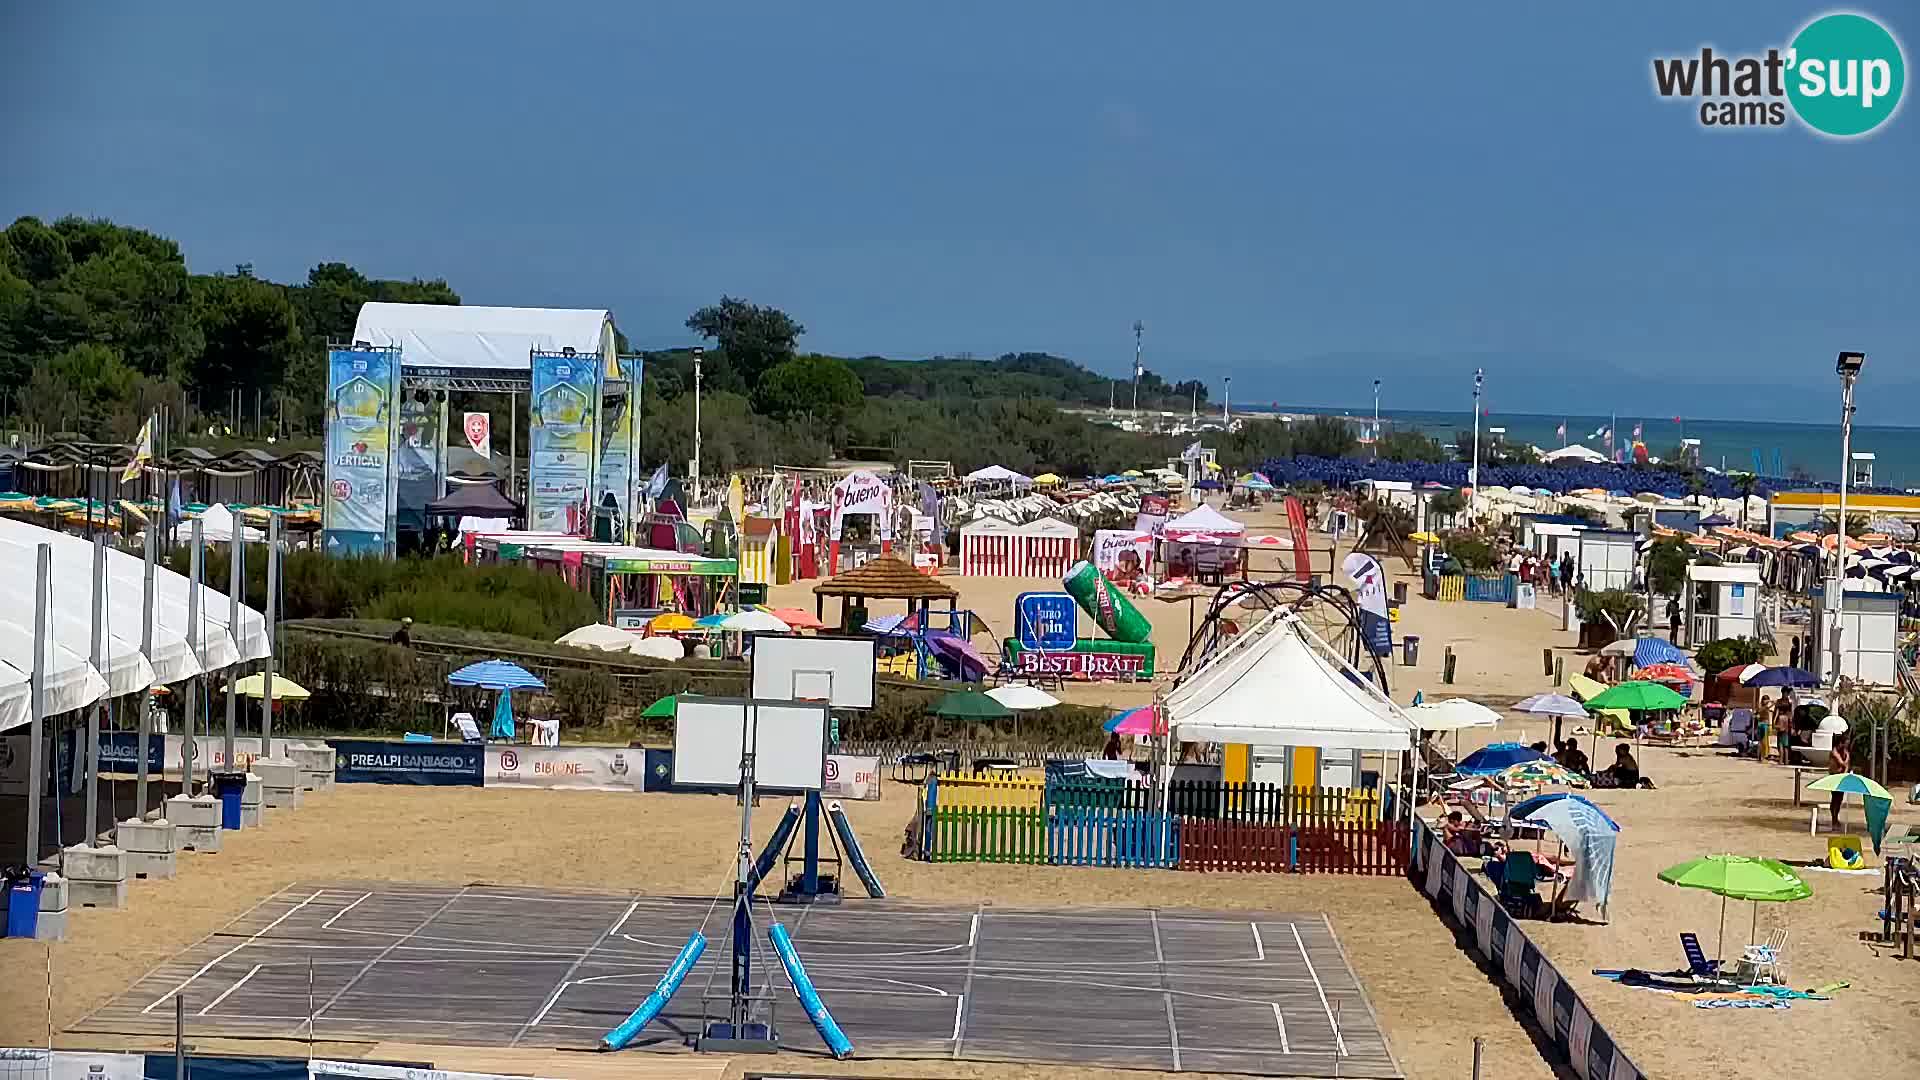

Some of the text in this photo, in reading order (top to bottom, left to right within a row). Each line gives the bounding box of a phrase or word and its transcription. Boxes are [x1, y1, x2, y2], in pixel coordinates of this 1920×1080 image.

[333, 455, 381, 467] VERTICAL
[844, 485, 880, 508] bueno
[1023, 653, 1076, 672] BEST
